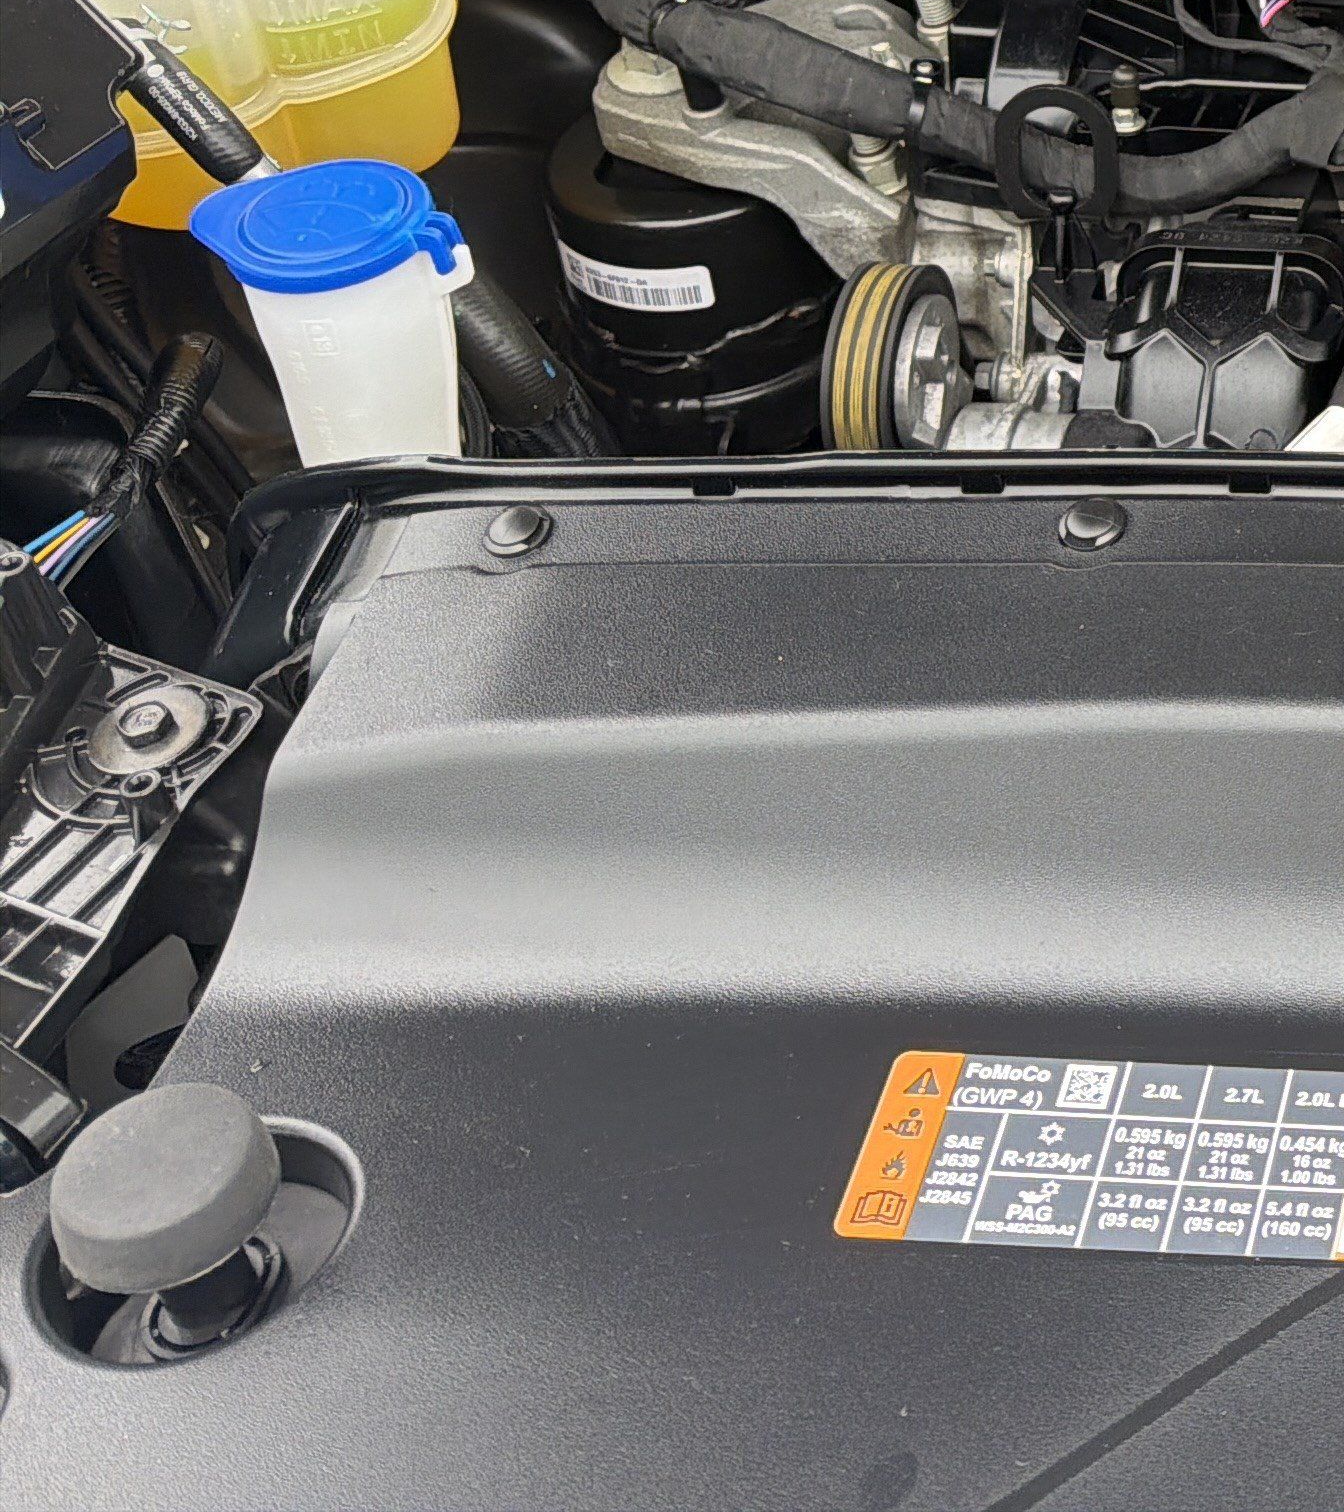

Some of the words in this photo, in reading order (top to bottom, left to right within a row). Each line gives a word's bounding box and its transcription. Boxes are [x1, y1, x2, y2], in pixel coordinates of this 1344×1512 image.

[965, 1062, 1051, 1082] FoMoCo
[952, 1086, 1018, 1107] (GWP
[1019, 1089, 1043, 1110] 4)
[1141, 1083, 1182, 1100] 2.0L
[1223, 1087, 1264, 1105] 2.7L
[1294, 1091, 1335, 1108] 2.0L
[943, 1134, 985, 1150] SAE
[1115, 1126, 1162, 1144] 0.595
[1164, 1129, 1187, 1150] kg
[1198, 1130, 1244, 1148] 0.595
[1246, 1134, 1269, 1154] kg
[1279, 1135, 1326, 1153] 0.454
[935, 1153, 980, 1168] J639
[1000, 1149, 1092, 1173] R-1234yf
[1125, 1145, 1144, 1160] 21
[1147, 1149, 1166, 1161] oz
[1208, 1150, 1228, 1164] 21
[1230, 1153, 1250, 1165] oz
[1293, 1154, 1311, 1168] 16
[1312, 1157, 1332, 1169] oz
[1114, 1161, 1144, 1175] 1.31
[1146, 1163, 1170, 1177] lbs
[1198, 1165, 1228, 1180] 1.31
[1230, 1167, 1253, 1182] lbs
[1280, 1170, 1311, 1184] 1.00
[1312, 1171, 1336, 1185] lbs
[924, 1171, 979, 1187] J2842
[919, 1189, 973, 1206] J2845
[1097, 1192, 1126, 1209] 3.2
[1128, 1194, 1143, 1209] fl
[1144, 1198, 1168, 1210] oz
[1182, 1196, 1211, 1213] 3.2
[1212, 1198, 1227, 1213] fl
[1229, 1202, 1253, 1215] oz
[1005, 1203, 1053, 1222] PAG
[1265, 1201, 1293, 1217] 5.4
[1295, 1202, 1310, 1218] fl
[1311, 1206, 1335, 1218] oz
[1098, 1212, 1129, 1230] (95
[1130, 1214, 1159, 1232] cc)
[1183, 1216, 1214, 1235] (95
[1215, 1218, 1245, 1236] cc)
[1261, 1220, 1301, 1238] (160
[1302, 1223, 1332, 1241] cc)
